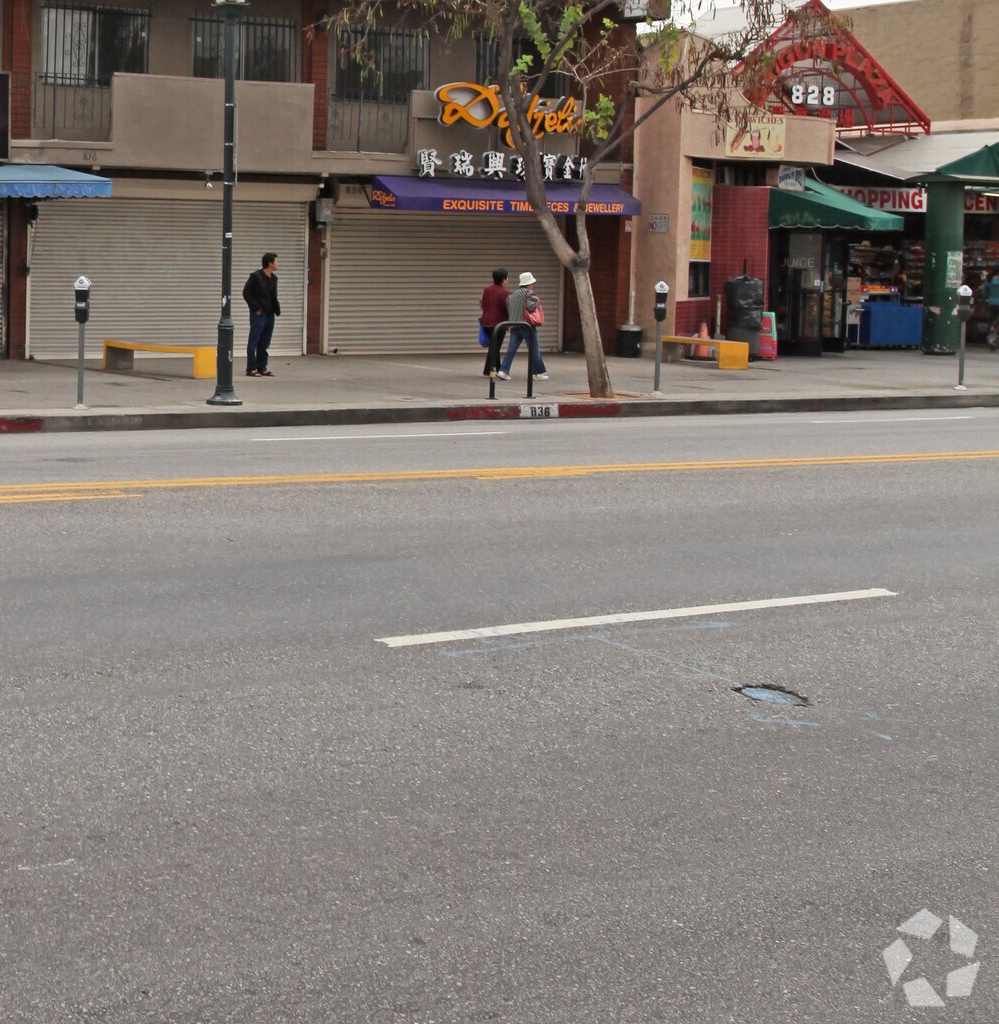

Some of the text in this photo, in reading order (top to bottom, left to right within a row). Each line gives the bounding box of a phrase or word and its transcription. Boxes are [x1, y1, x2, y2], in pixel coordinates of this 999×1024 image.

[791, 84, 835, 106] 828
[443, 199, 504, 211] EXQUISITE
[779, 257, 815, 268] JUICE
[530, 406, 550, 417] 836
